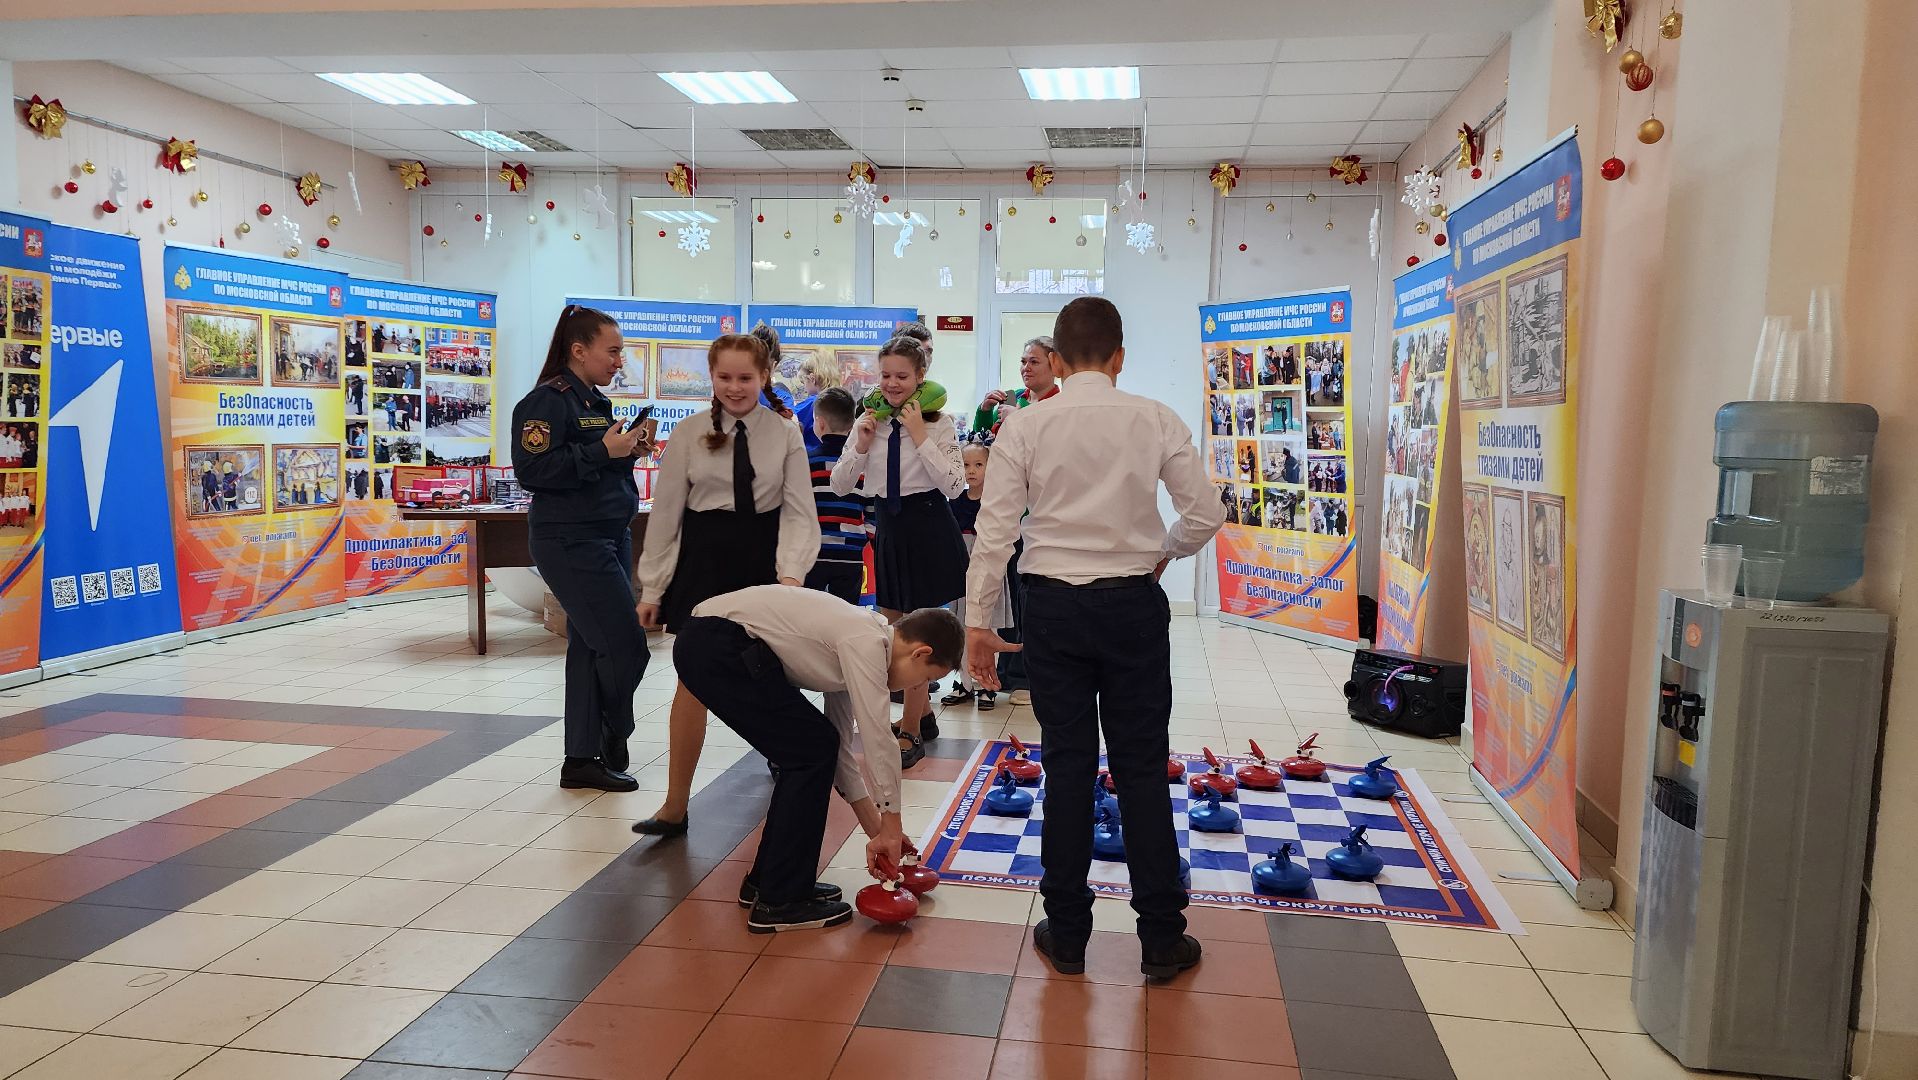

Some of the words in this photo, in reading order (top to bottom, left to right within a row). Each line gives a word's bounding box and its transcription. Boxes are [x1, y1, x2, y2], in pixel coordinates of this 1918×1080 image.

[0, 223, 19, 240] СИИ
[52, 276, 80, 284] ение
[196, 268, 233, 282] ГЛАВНОЕ
[233, 272, 280, 288] УПРАВЛЕНИЕ
[281, 279, 298, 290] МЧС
[298, 282, 326, 294] РОССИИ
[214, 284, 224, 295] ПО
[227, 286, 280, 302] МОСКОВСКОЙ
[280, 294, 312, 306] ОБЛАСТИ
[432, 295, 447, 306] МЧС
[448, 297, 476, 308] РОССИИ
[367, 300, 377, 310] ПО
[379, 301, 430, 316] МОСКОВСКОЙ
[1284, 305, 1299, 316] МЧС
[1300, 302, 1326, 314] РОССИИ
[624, 312, 670, 322] УПРАВЛЕНИЕ
[670, 314, 687, 322] МЧС
[688, 315, 716, 324] РОССИИ
[770, 318, 802, 327] ГЛАВНОЕ
[802, 318, 847, 328] УПРАВЛЕНИЕ
[848, 320, 864, 328] МЧС
[865, 320, 892, 329] РОССИИ
[668, 324, 702, 334] ОБЛАСТИ
[785, 329, 795, 338] ПО
[796, 328, 844, 338] МОСКОВСКОЙ
[845, 330, 878, 340] ОБЛАСТИ
[50, 324, 122, 352] ервые
[219, 392, 312, 410] БезОпасность
[217, 413, 274, 427] глазами
[278, 411, 315, 428] детей
[1478, 421, 1541, 448] БезОпасность
[1478, 455, 1510, 478] глазами
[1512, 451, 1544, 484] детей
[372, 552, 460, 570] БезОпасности
[1226, 560, 1302, 585] Профилактика
[1311, 576, 1344, 592] залог
[1246, 583, 1322, 610] БезОпасности
[962, 874, 1040, 886] ПОЖАРН
[1189, 893, 1271, 906] ОДСКОЙ
[1276, 901, 1338, 912] ОКРУГ
[1344, 906, 1438, 920] МЫТИЩИ
